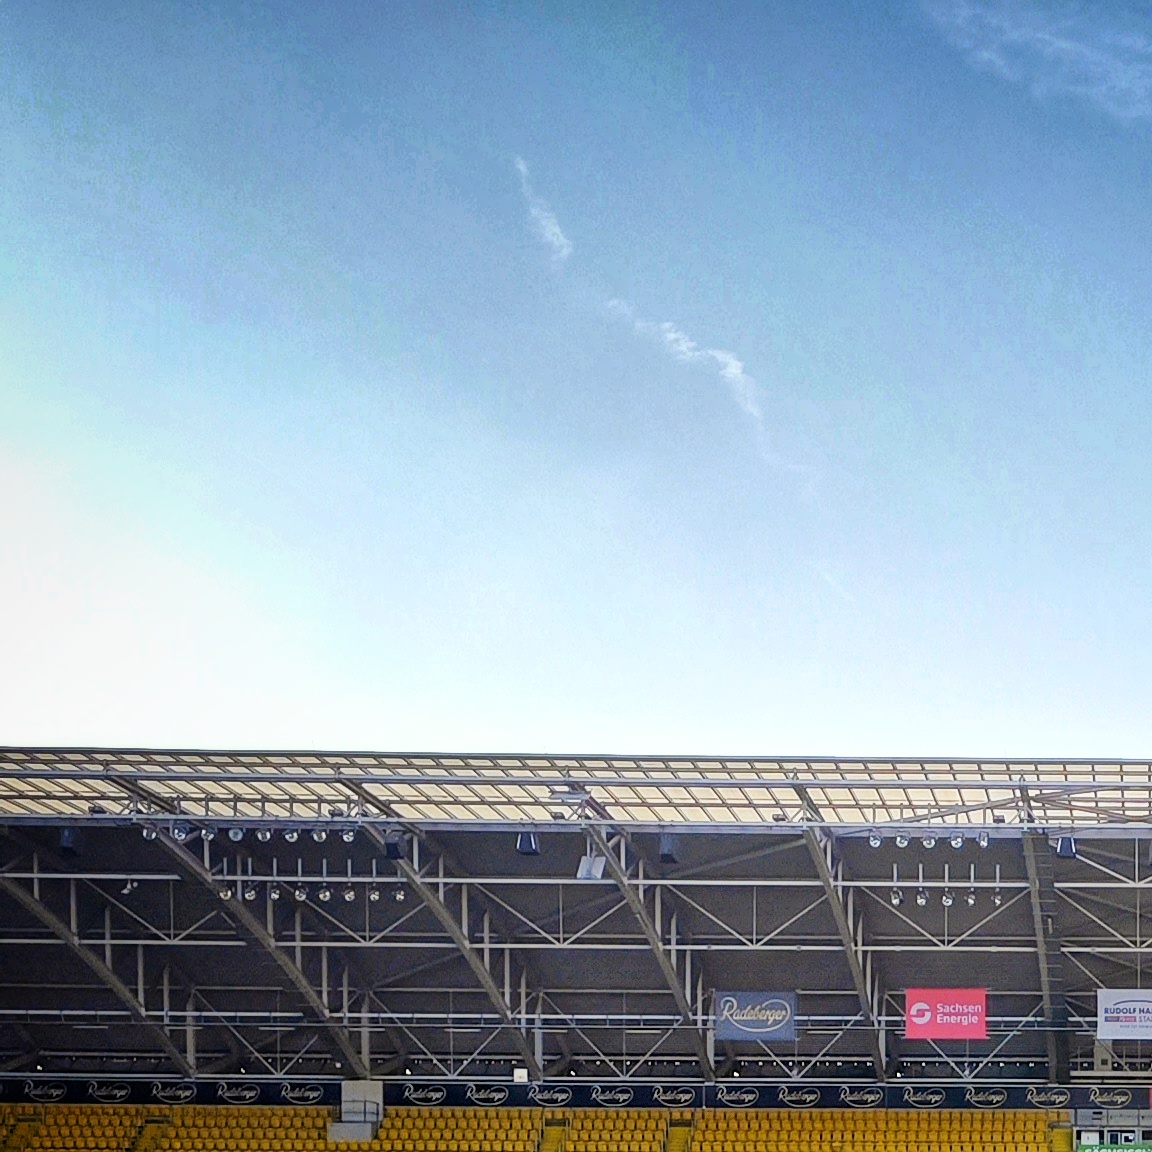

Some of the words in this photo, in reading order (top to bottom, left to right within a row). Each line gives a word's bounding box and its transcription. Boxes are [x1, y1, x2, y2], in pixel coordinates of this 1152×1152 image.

[719, 996, 791, 1032] Radeberger
[936, 1003, 982, 1014] Sachsen
[1104, 1007, 1137, 1015] RUDOLF
[936, 1013, 979, 1025] Energie
